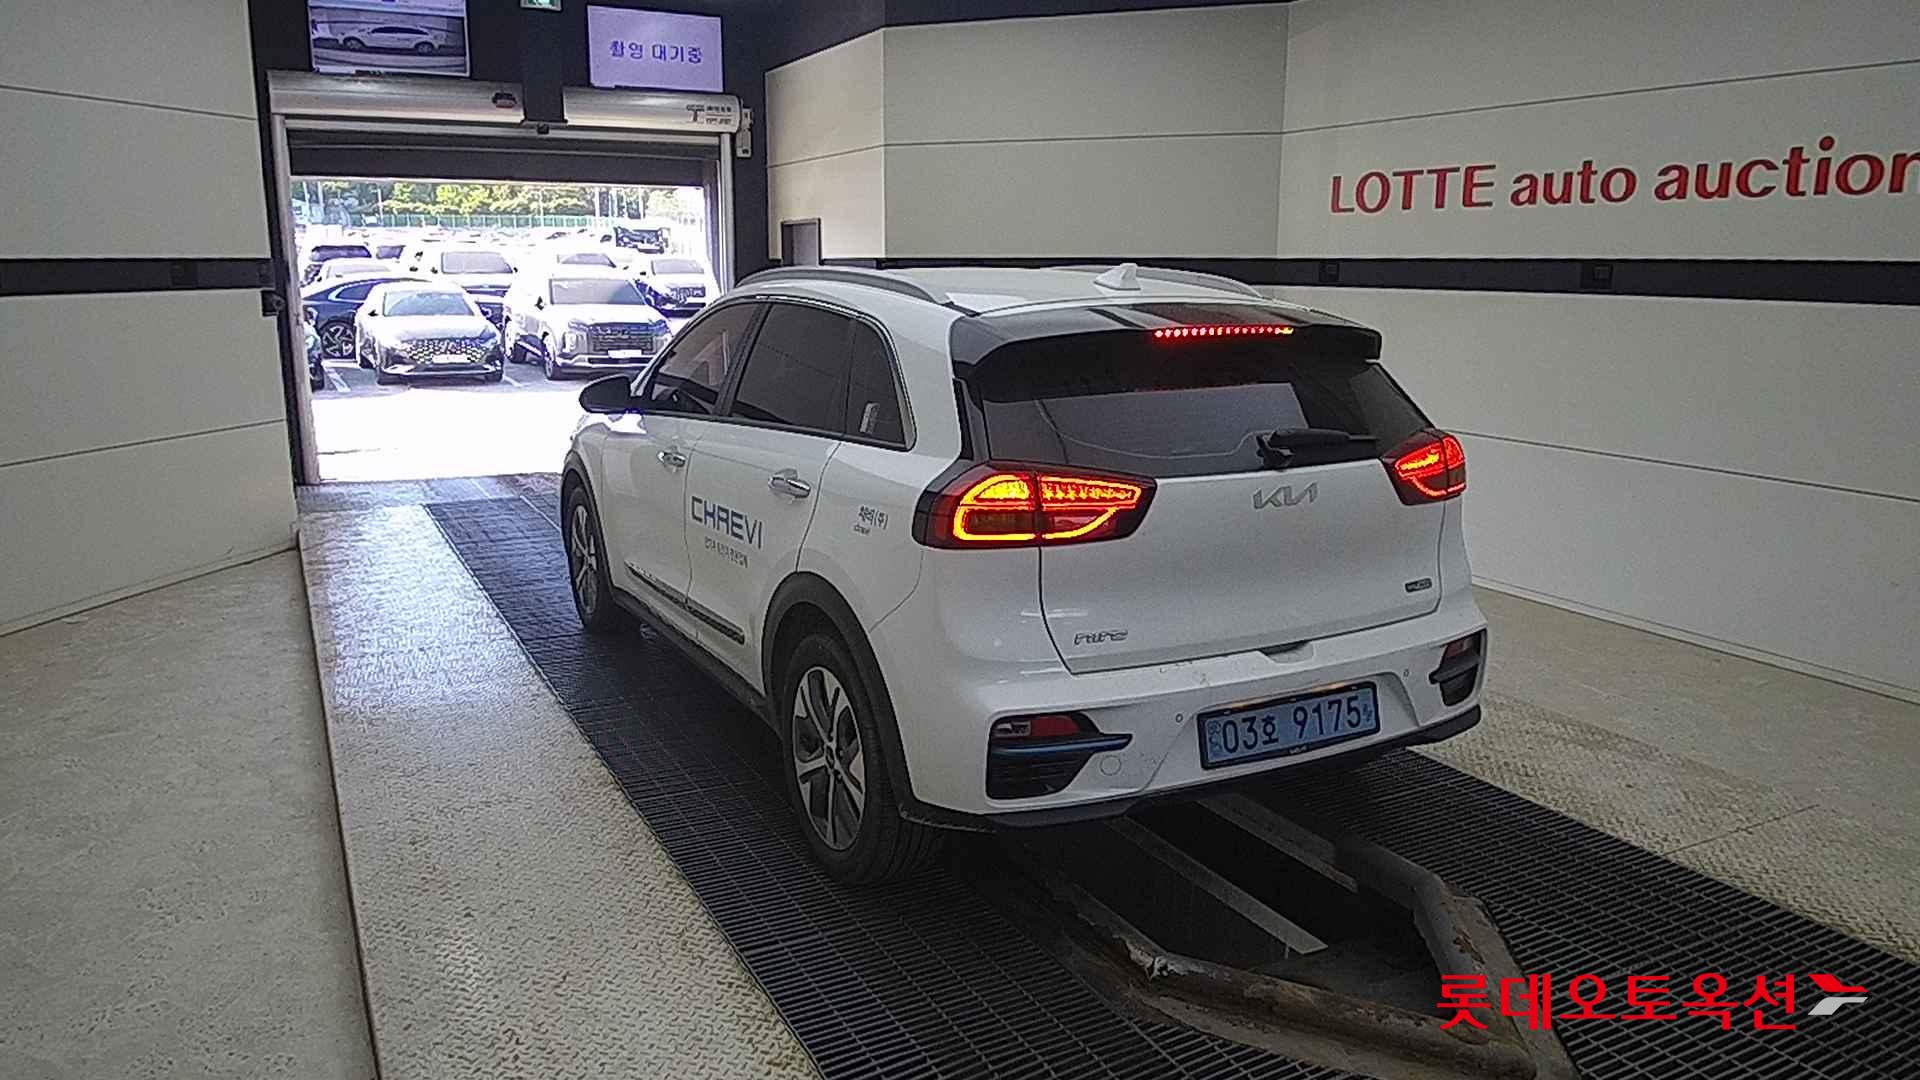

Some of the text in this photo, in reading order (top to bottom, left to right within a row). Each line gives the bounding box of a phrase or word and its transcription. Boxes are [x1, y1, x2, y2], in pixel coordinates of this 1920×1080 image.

[1330, 163, 1497, 214] LOTTE
[1509, 159, 1637, 206] auto
[1222, 715, 1279, 754] 03호
[1293, 695, 1361, 740] 9175
